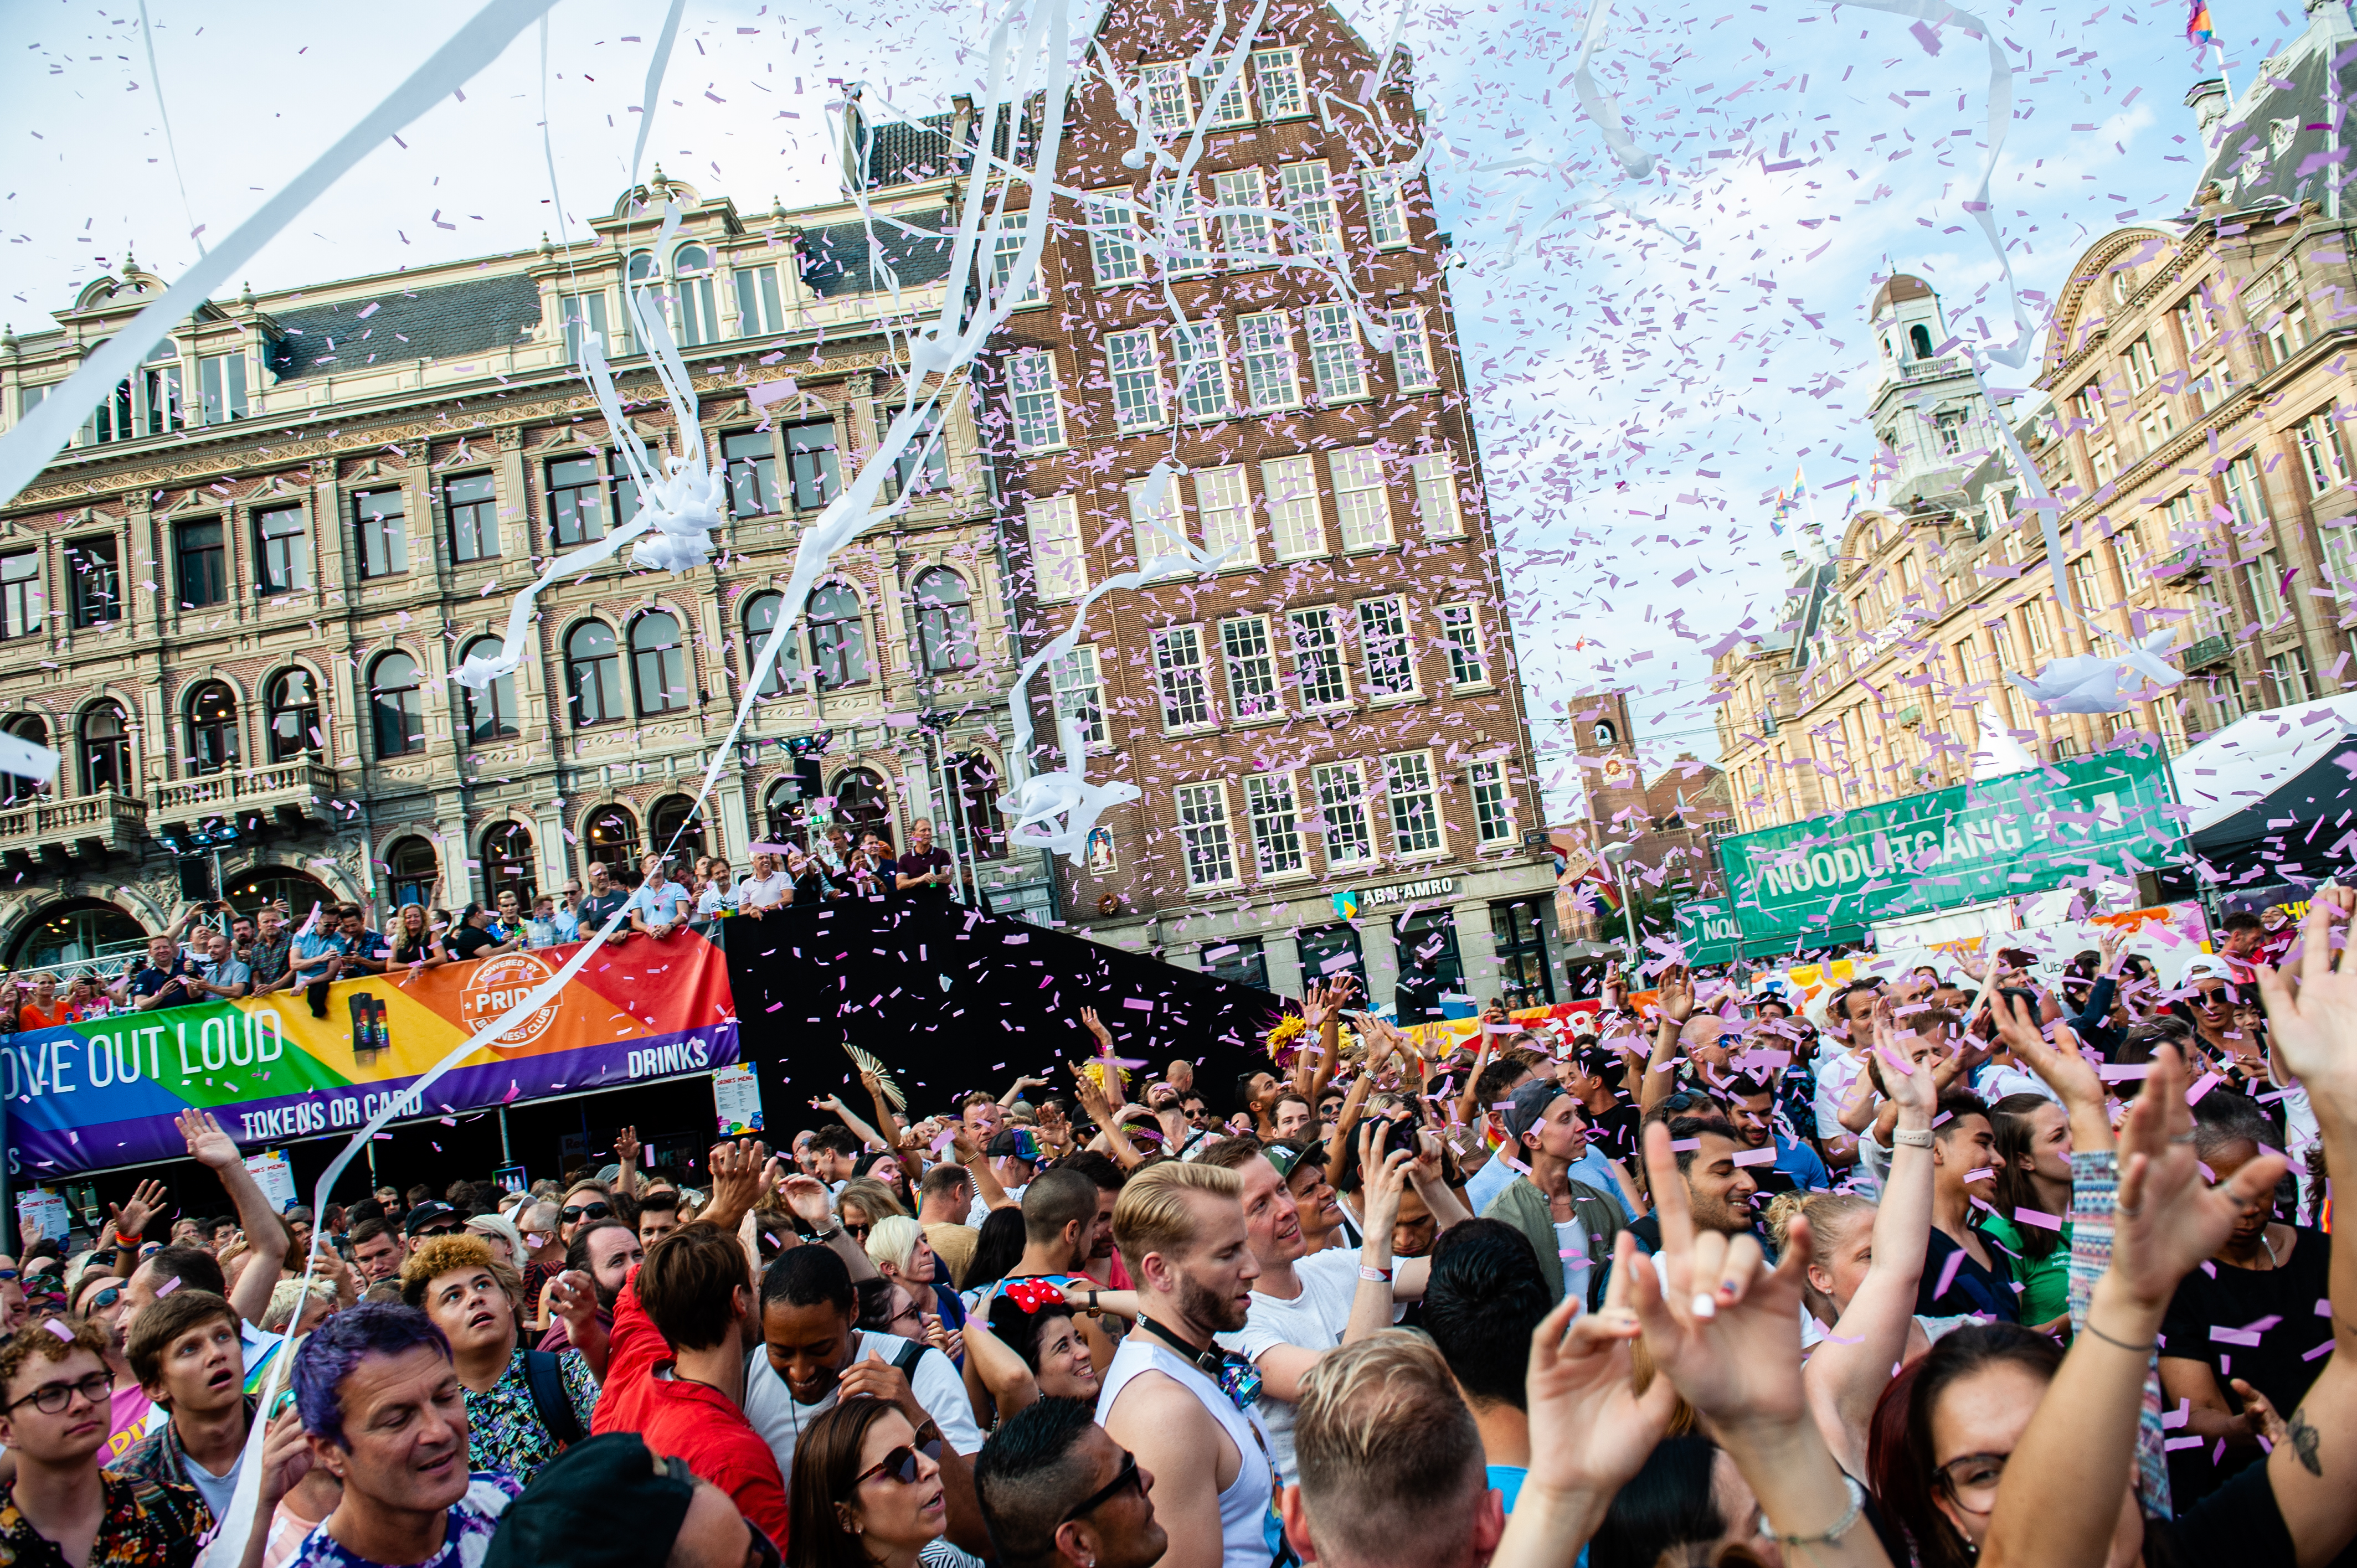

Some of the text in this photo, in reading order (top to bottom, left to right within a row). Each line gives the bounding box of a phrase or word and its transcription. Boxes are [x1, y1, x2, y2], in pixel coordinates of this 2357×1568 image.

[1764, 814, 2024, 897] NOODUITGANG
[478, 960, 541, 982] POWERED BY
[2043, 961, 2068, 973] Ube
[476, 985, 543, 1013] PRID
[476, 1008, 551, 1041] BNESS CLUB
[88, 1025, 165, 1088] OUT
[177, 1009, 284, 1075] LOUD
[627, 1039, 709, 1079] DRINKS
[240, 1102, 326, 1141] TOKENS
[330, 1097, 361, 1127] OR
